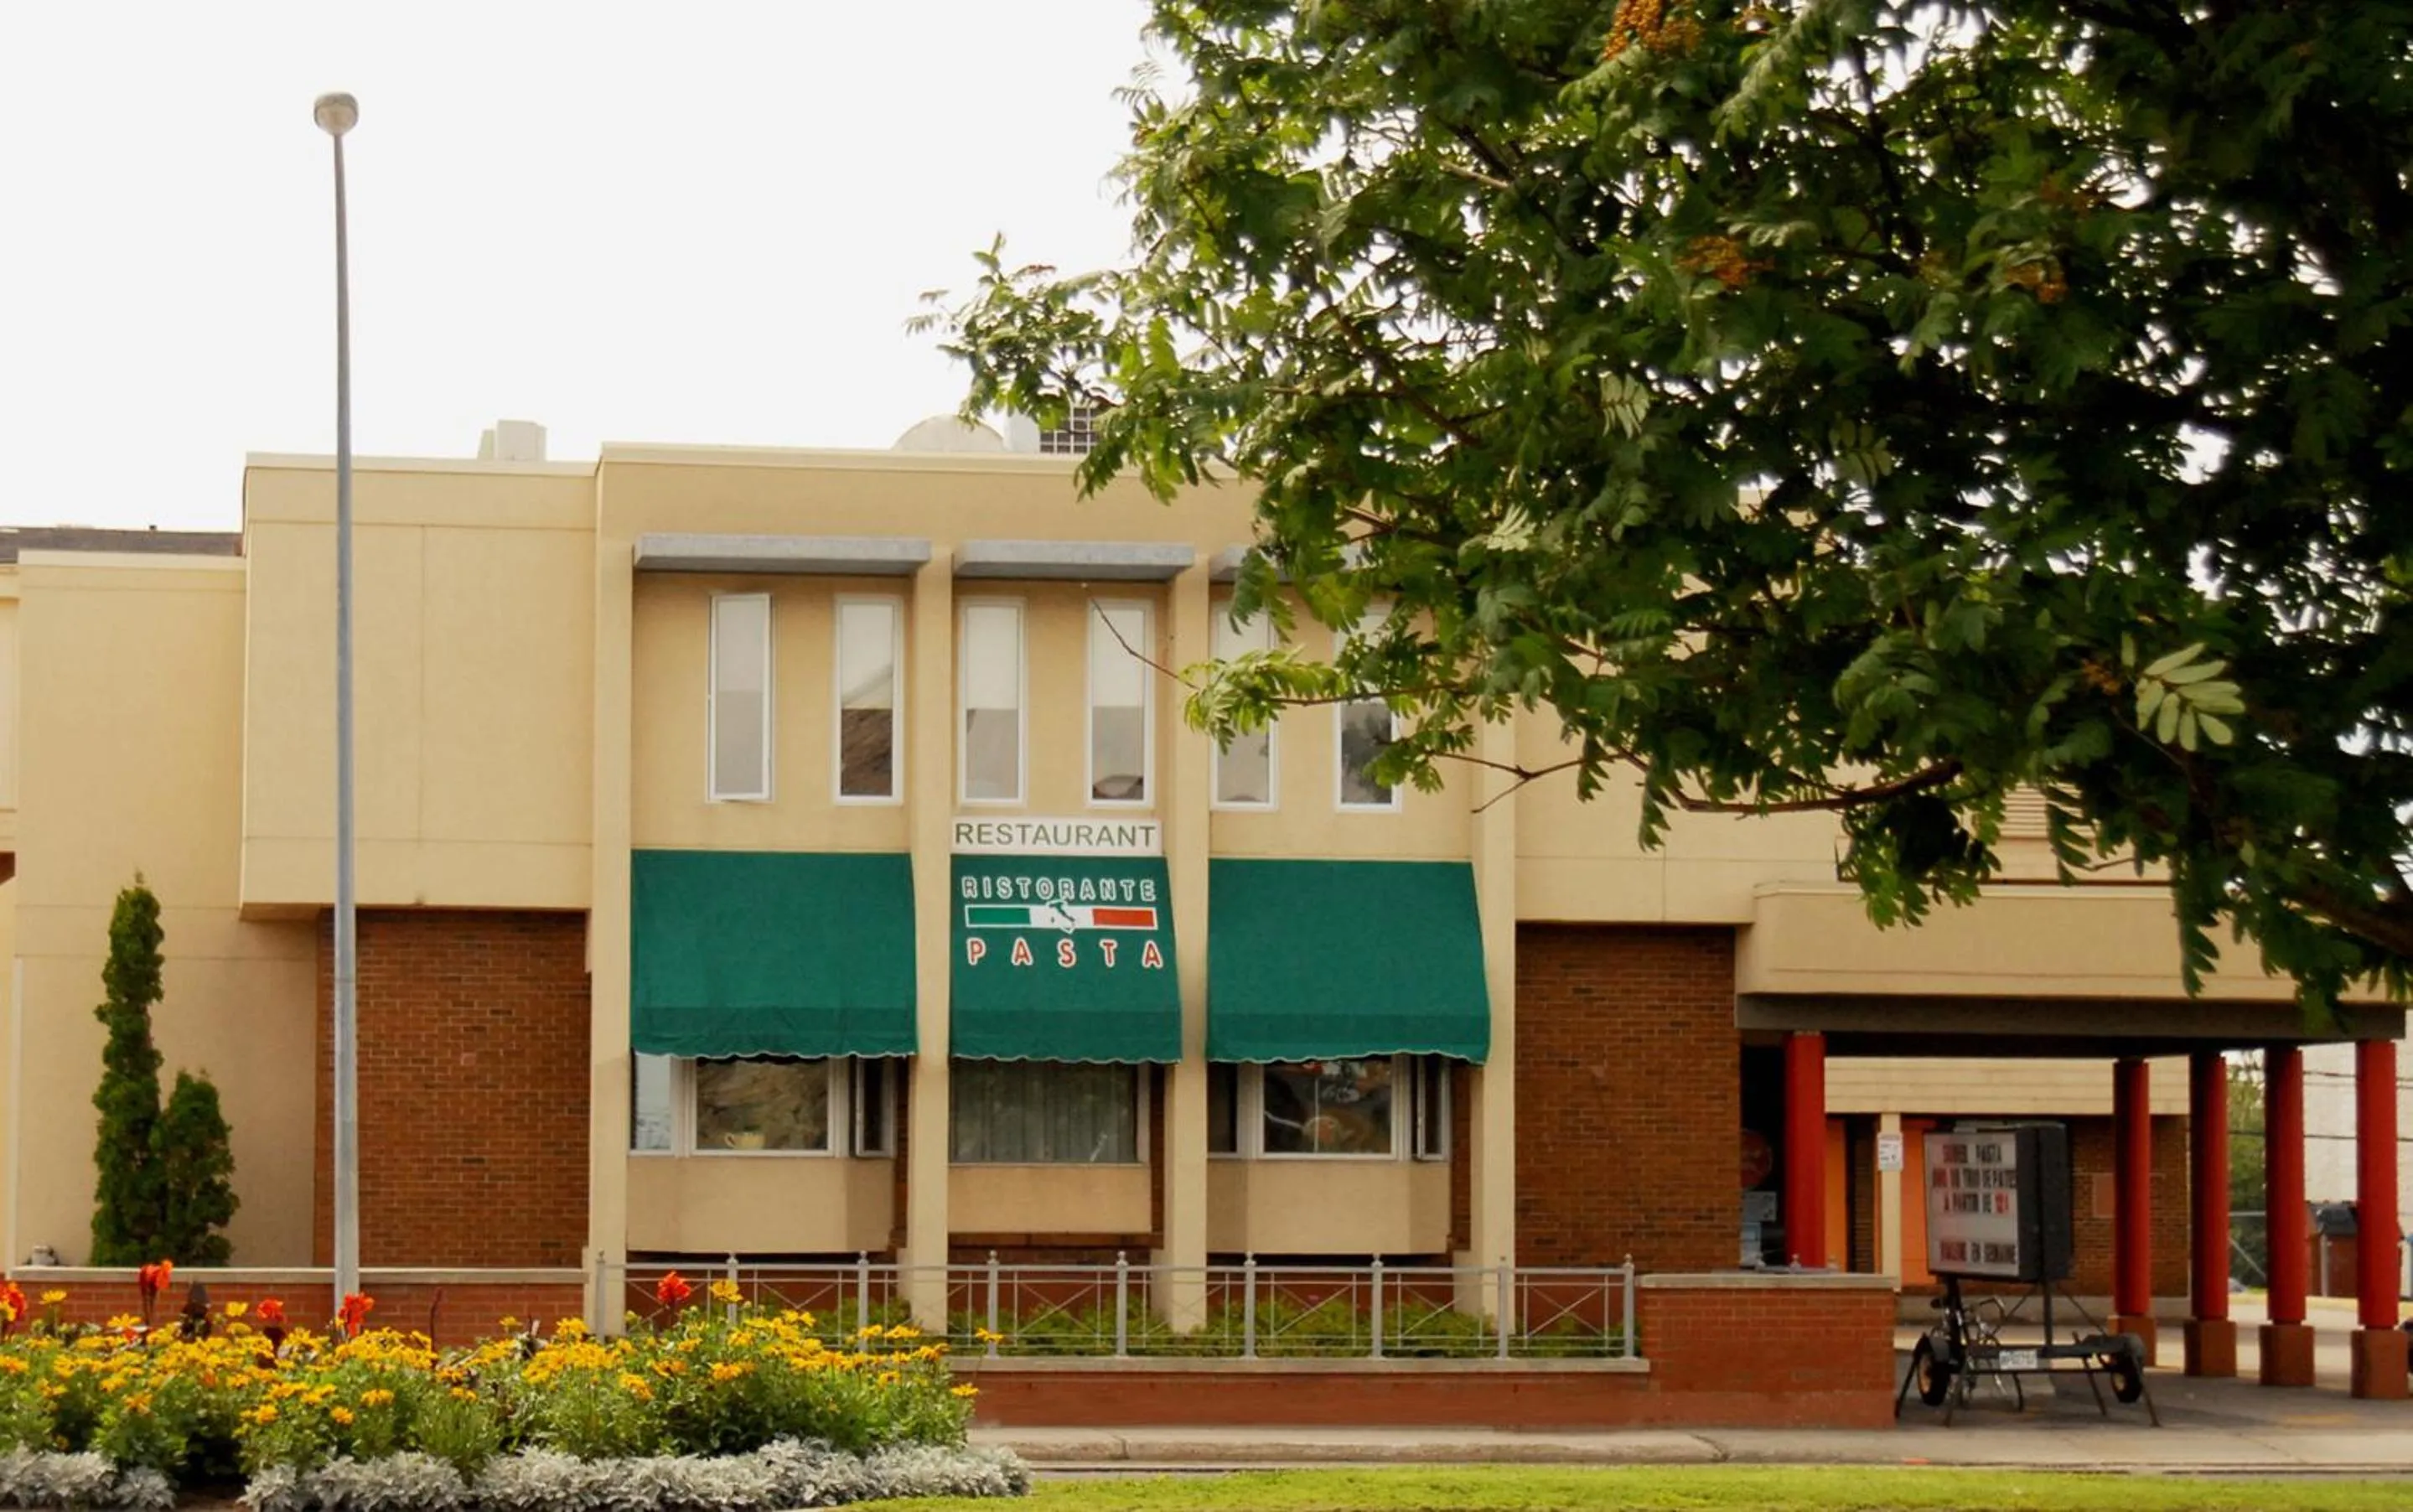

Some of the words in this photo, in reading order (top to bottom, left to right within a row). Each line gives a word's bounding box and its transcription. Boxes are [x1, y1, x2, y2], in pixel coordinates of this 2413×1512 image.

[955, 822, 1156, 847] RESTAURANT
[962, 876, 1157, 902] RISTORANTE
[966, 937, 1163, 968] PASTA
